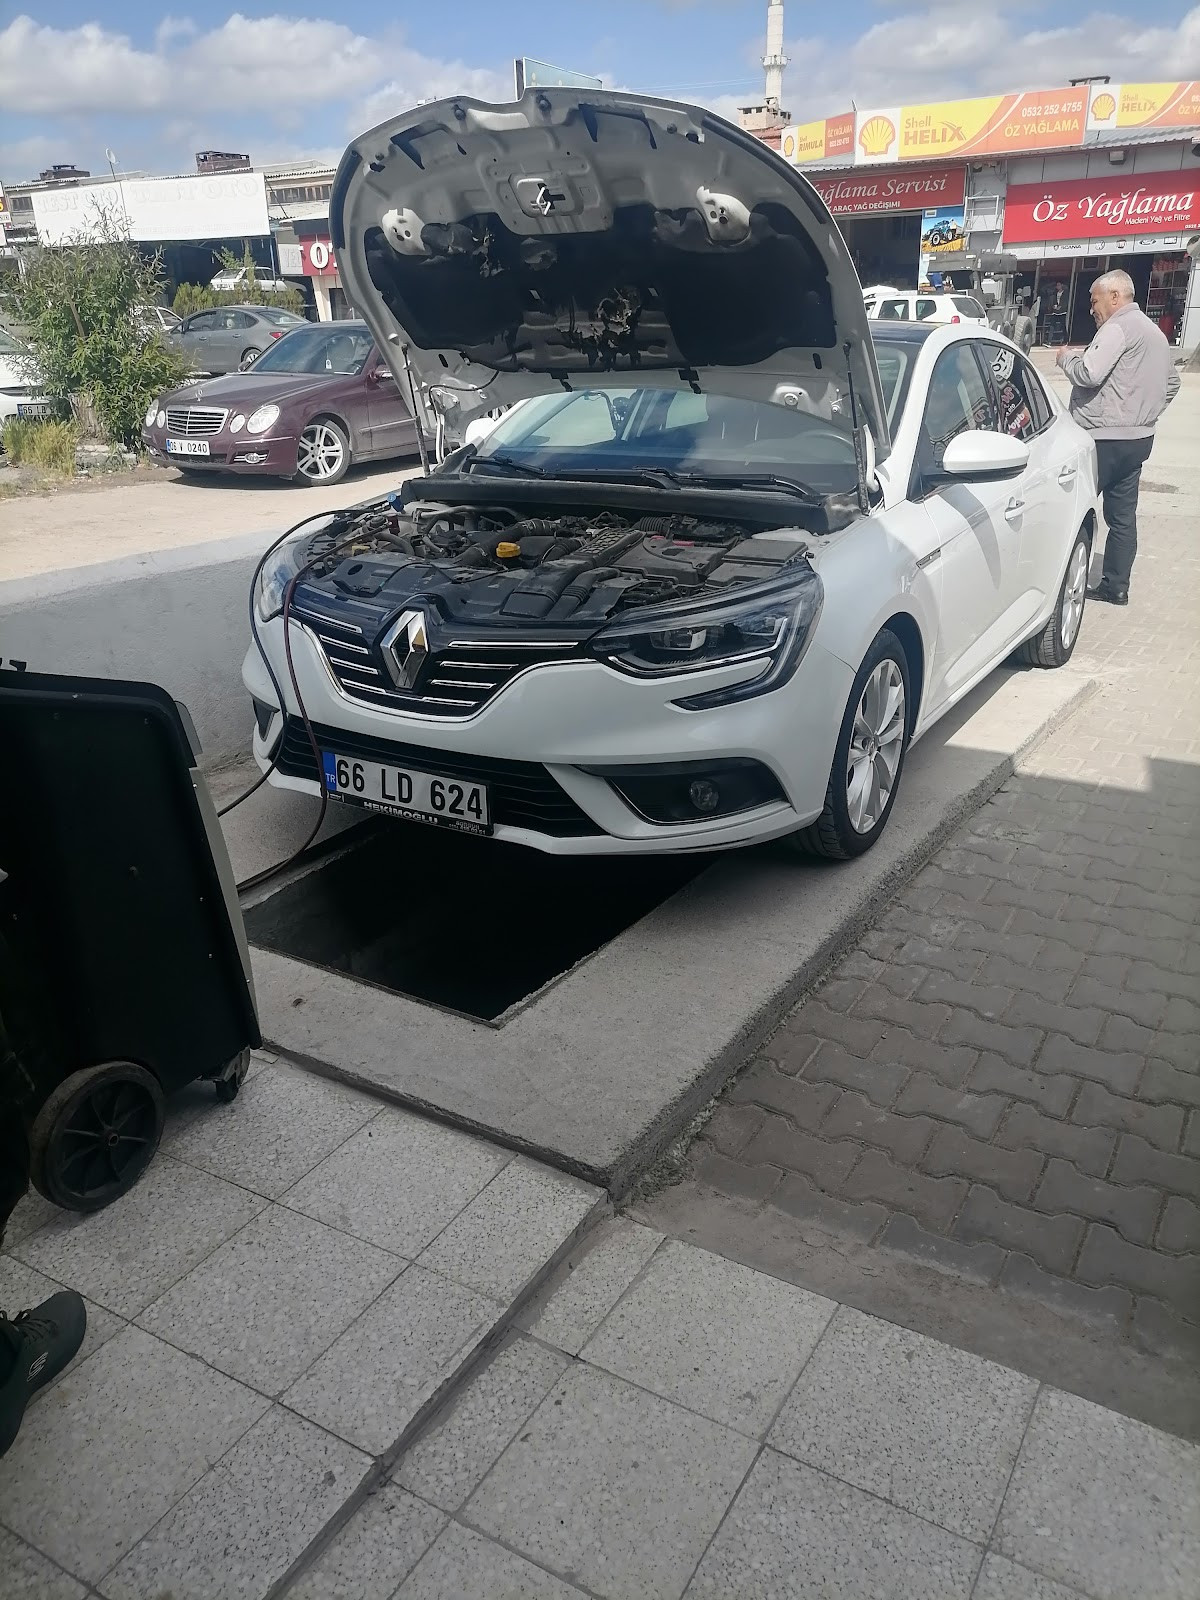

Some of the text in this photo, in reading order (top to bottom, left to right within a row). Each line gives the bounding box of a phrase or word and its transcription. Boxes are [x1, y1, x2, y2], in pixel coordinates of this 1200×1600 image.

[1022, 101, 1082, 118] 0532 252 4755
[1121, 99, 1157, 112] HELIX
[1178, 104, 1191, 115] ÖZ
[905, 116, 931, 129] Shell
[1004, 118, 1080, 138] ÖZ YAĞLAMA
[904, 122, 966, 146] HELIX
[798, 140, 823, 152] RIMULA
[882, 174, 948, 197] Servisi
[833, 204, 852, 213] ARAÇ
[853, 202, 868, 211] YAĞ
[1033, 188, 1194, 225] Öz Yağlama
[1125, 216, 1149, 225] Madeni
[1150, 215, 1163, 224] Yağ
[1173, 213, 1190, 221] Filtre
[187, 442, 208, 453] 0240
[325, 759, 482, 819] TR 66 LD 624
